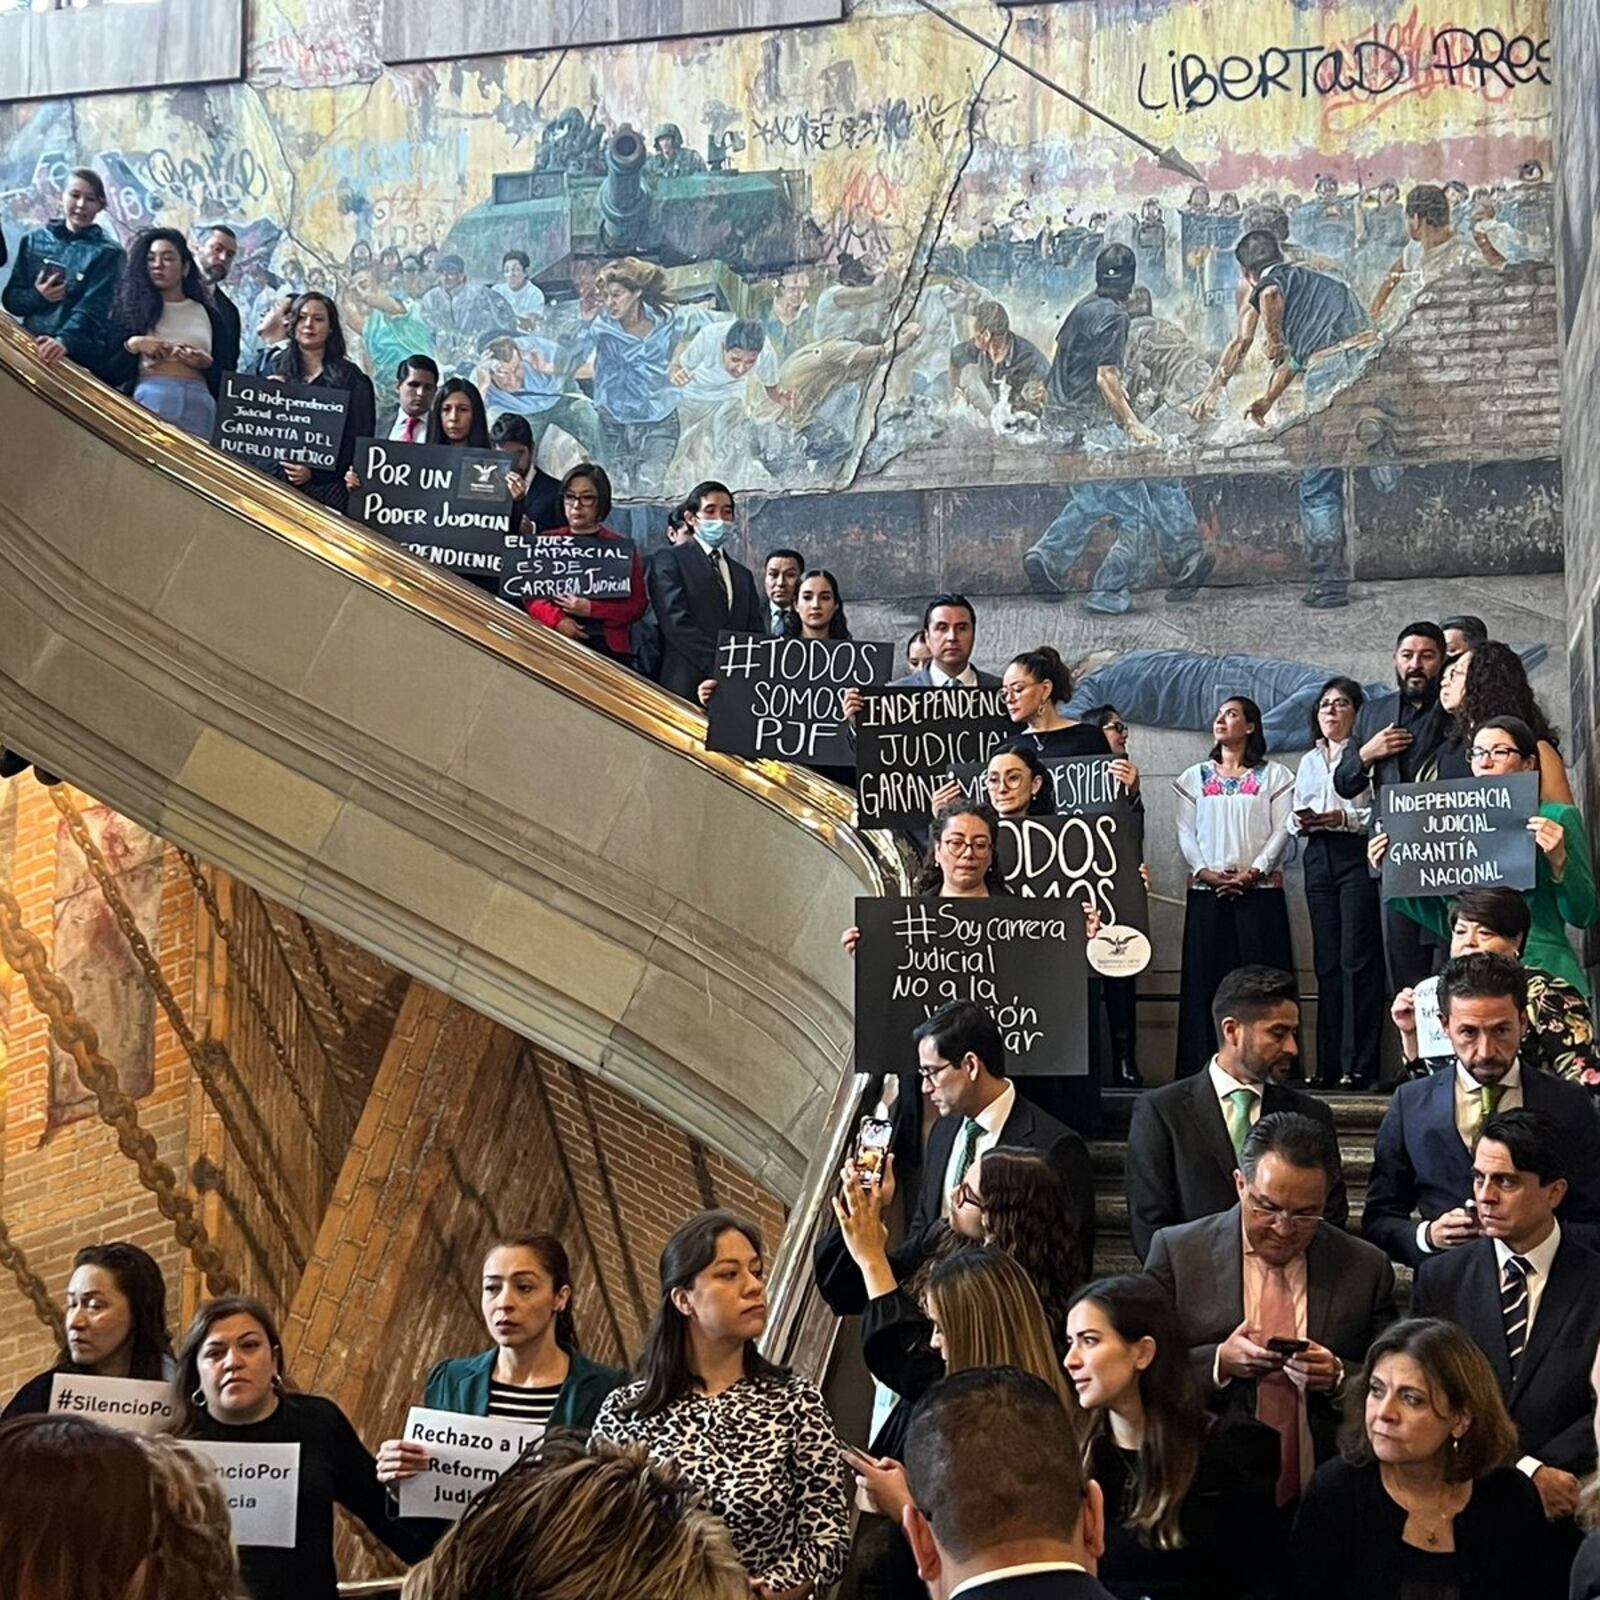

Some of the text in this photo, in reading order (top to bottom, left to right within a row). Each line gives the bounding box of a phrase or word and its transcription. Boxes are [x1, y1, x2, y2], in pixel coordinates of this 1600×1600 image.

[227, 380, 254, 401] La
[221, 419, 333, 447] GARANTÍA DEL
[221, 438, 271, 457] PUEBLO
[273, 447, 287, 460] DE
[367, 446, 452, 489] POR UN
[364, 493, 427, 524] PODER
[505, 535, 575, 548] EL JUEZ
[527, 547, 629, 559] IMPARCIAL
[516, 560, 583, 575] ES DE
[504, 575, 580, 597] CARRERA
[719, 635, 877, 685] #TODOS
[751, 681, 847, 722] SOMOS
[862, 689, 1007, 726] INDEPENDENC
[756, 717, 839, 756] PJF
[878, 731, 1007, 767] JUDICIA
[1389, 787, 1511, 813] INDEPENDENCIA
[1423, 813, 1496, 834] JUDICIAL
[998, 815, 1117, 880] ODOS
[1390, 836, 1478, 865] GARANTÍA
[1420, 860, 1503, 887] NACIONAL
[892, 903, 1067, 946] #Soy carrera
[898, 944, 995, 974] judicial
[938, 980, 958, 1001] a
[970, 975, 999, 1005] la
[57, 1389, 172, 1417] #SilencioPo
[412, 1423, 493, 1450] Rechazo
[500, 1439, 511, 1451] a
[428, 1458, 499, 1482] Reform
